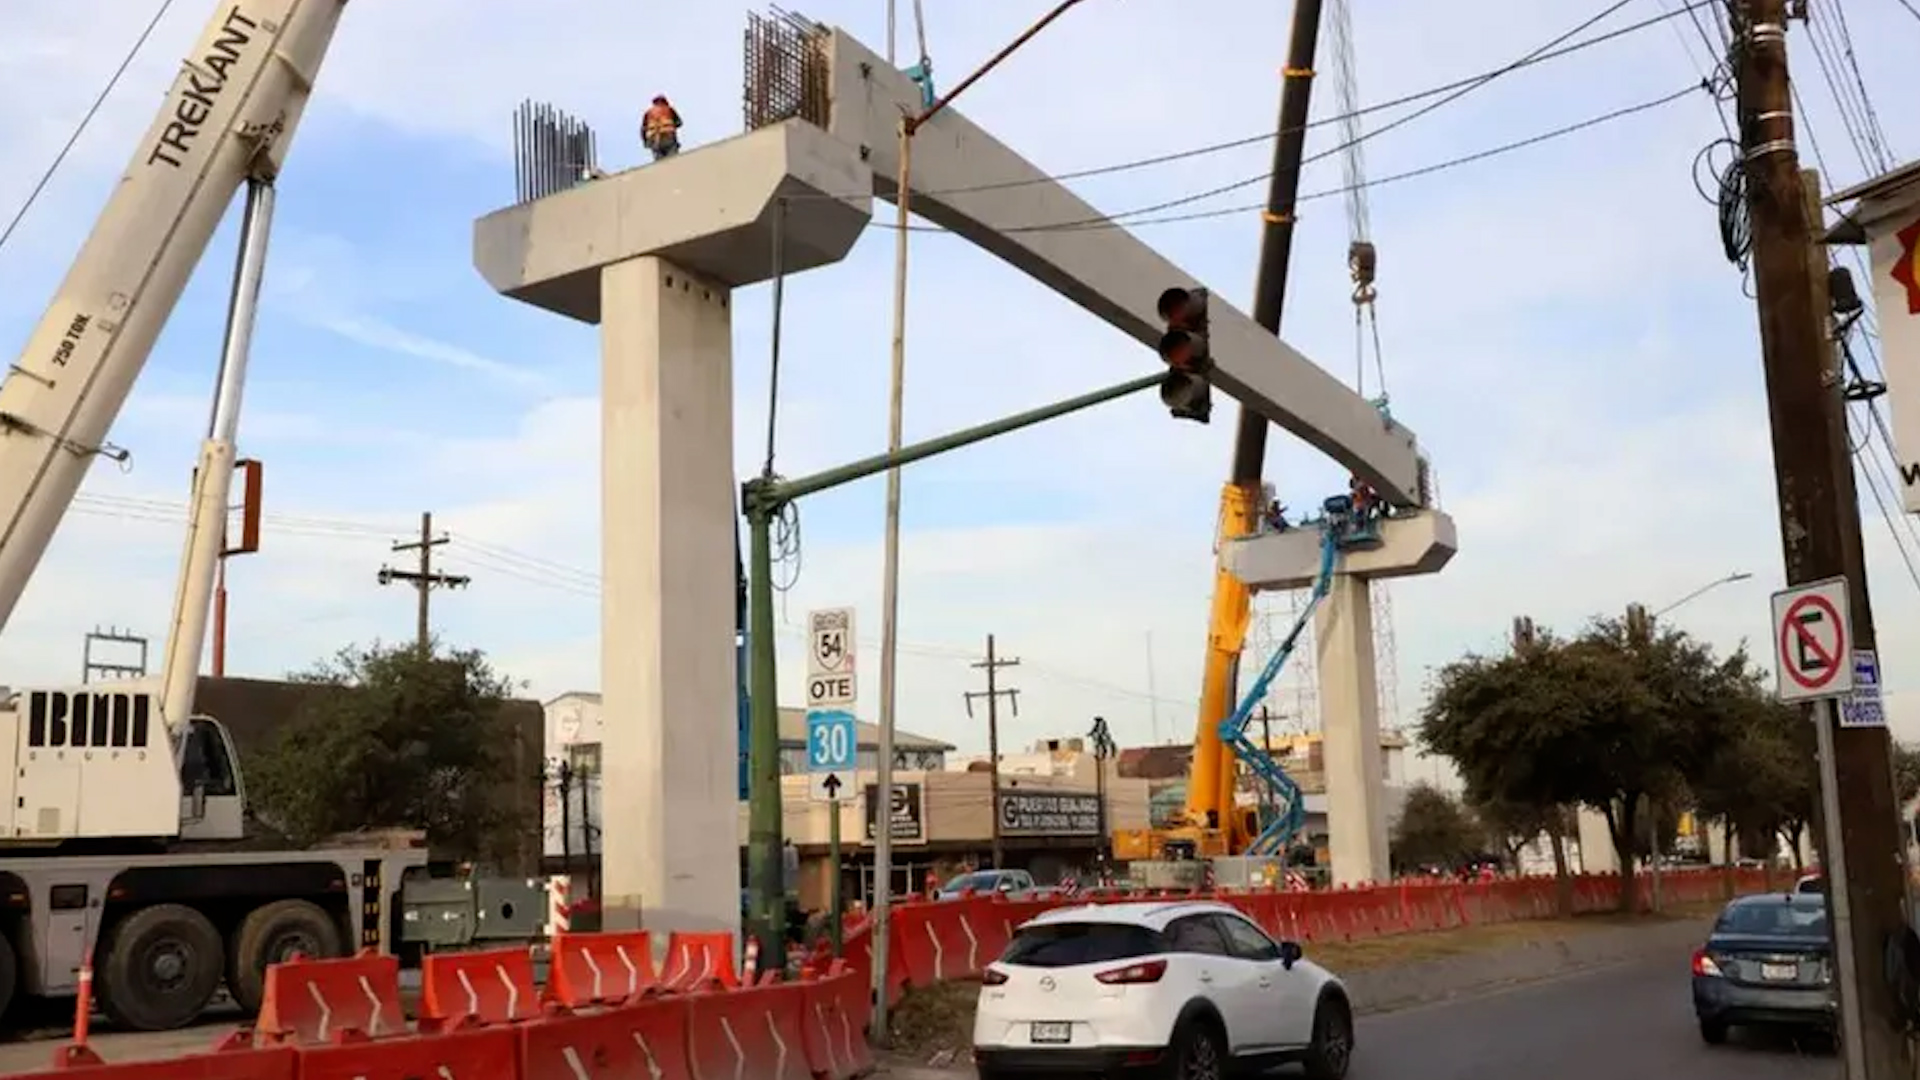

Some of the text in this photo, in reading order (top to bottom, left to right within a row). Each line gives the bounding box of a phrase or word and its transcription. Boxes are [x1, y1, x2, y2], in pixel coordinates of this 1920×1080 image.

[148, 5, 257, 168] TREKANT
[52, 339, 75, 368] 250
[821, 634, 841, 658] 54
[811, 678, 850, 699] OTE
[814, 723, 847, 765] 30
